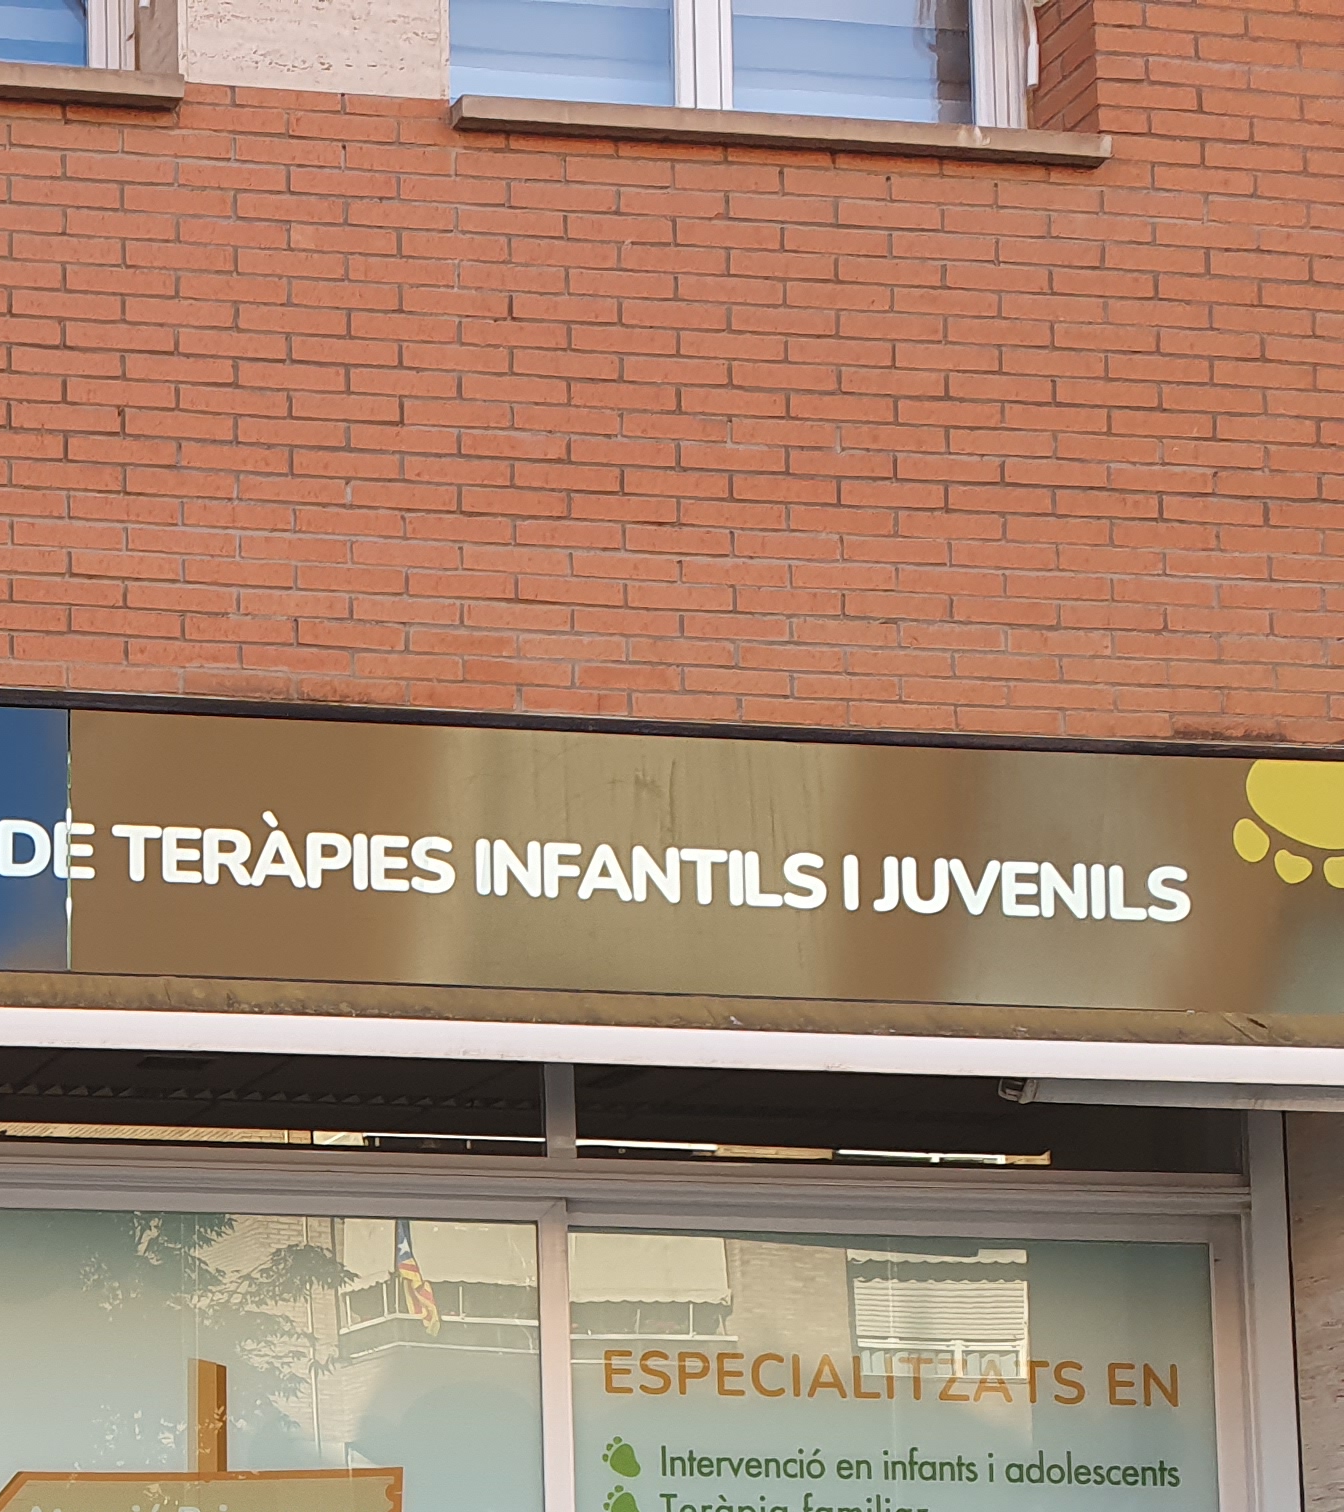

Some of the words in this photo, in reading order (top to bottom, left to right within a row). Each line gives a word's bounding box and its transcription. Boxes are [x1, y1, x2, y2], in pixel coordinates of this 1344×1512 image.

[112, 810, 456, 894] TERÀPIES
[475, 838, 827, 910] INFANTILS
[843, 854, 860, 911] I
[873, 855, 1191, 922] JUVENILS
[602, 1348, 1086, 1405] ESPECIALITZATS
[1107, 1360, 1180, 1407] EN
[660, 1445, 826, 1480] Intervenció
[836, 1454, 873, 1481] en
[883, 1446, 979, 1483] infants
[988, 1452, 995, 1483] i
[1005, 1450, 1181, 1488] adolescents
